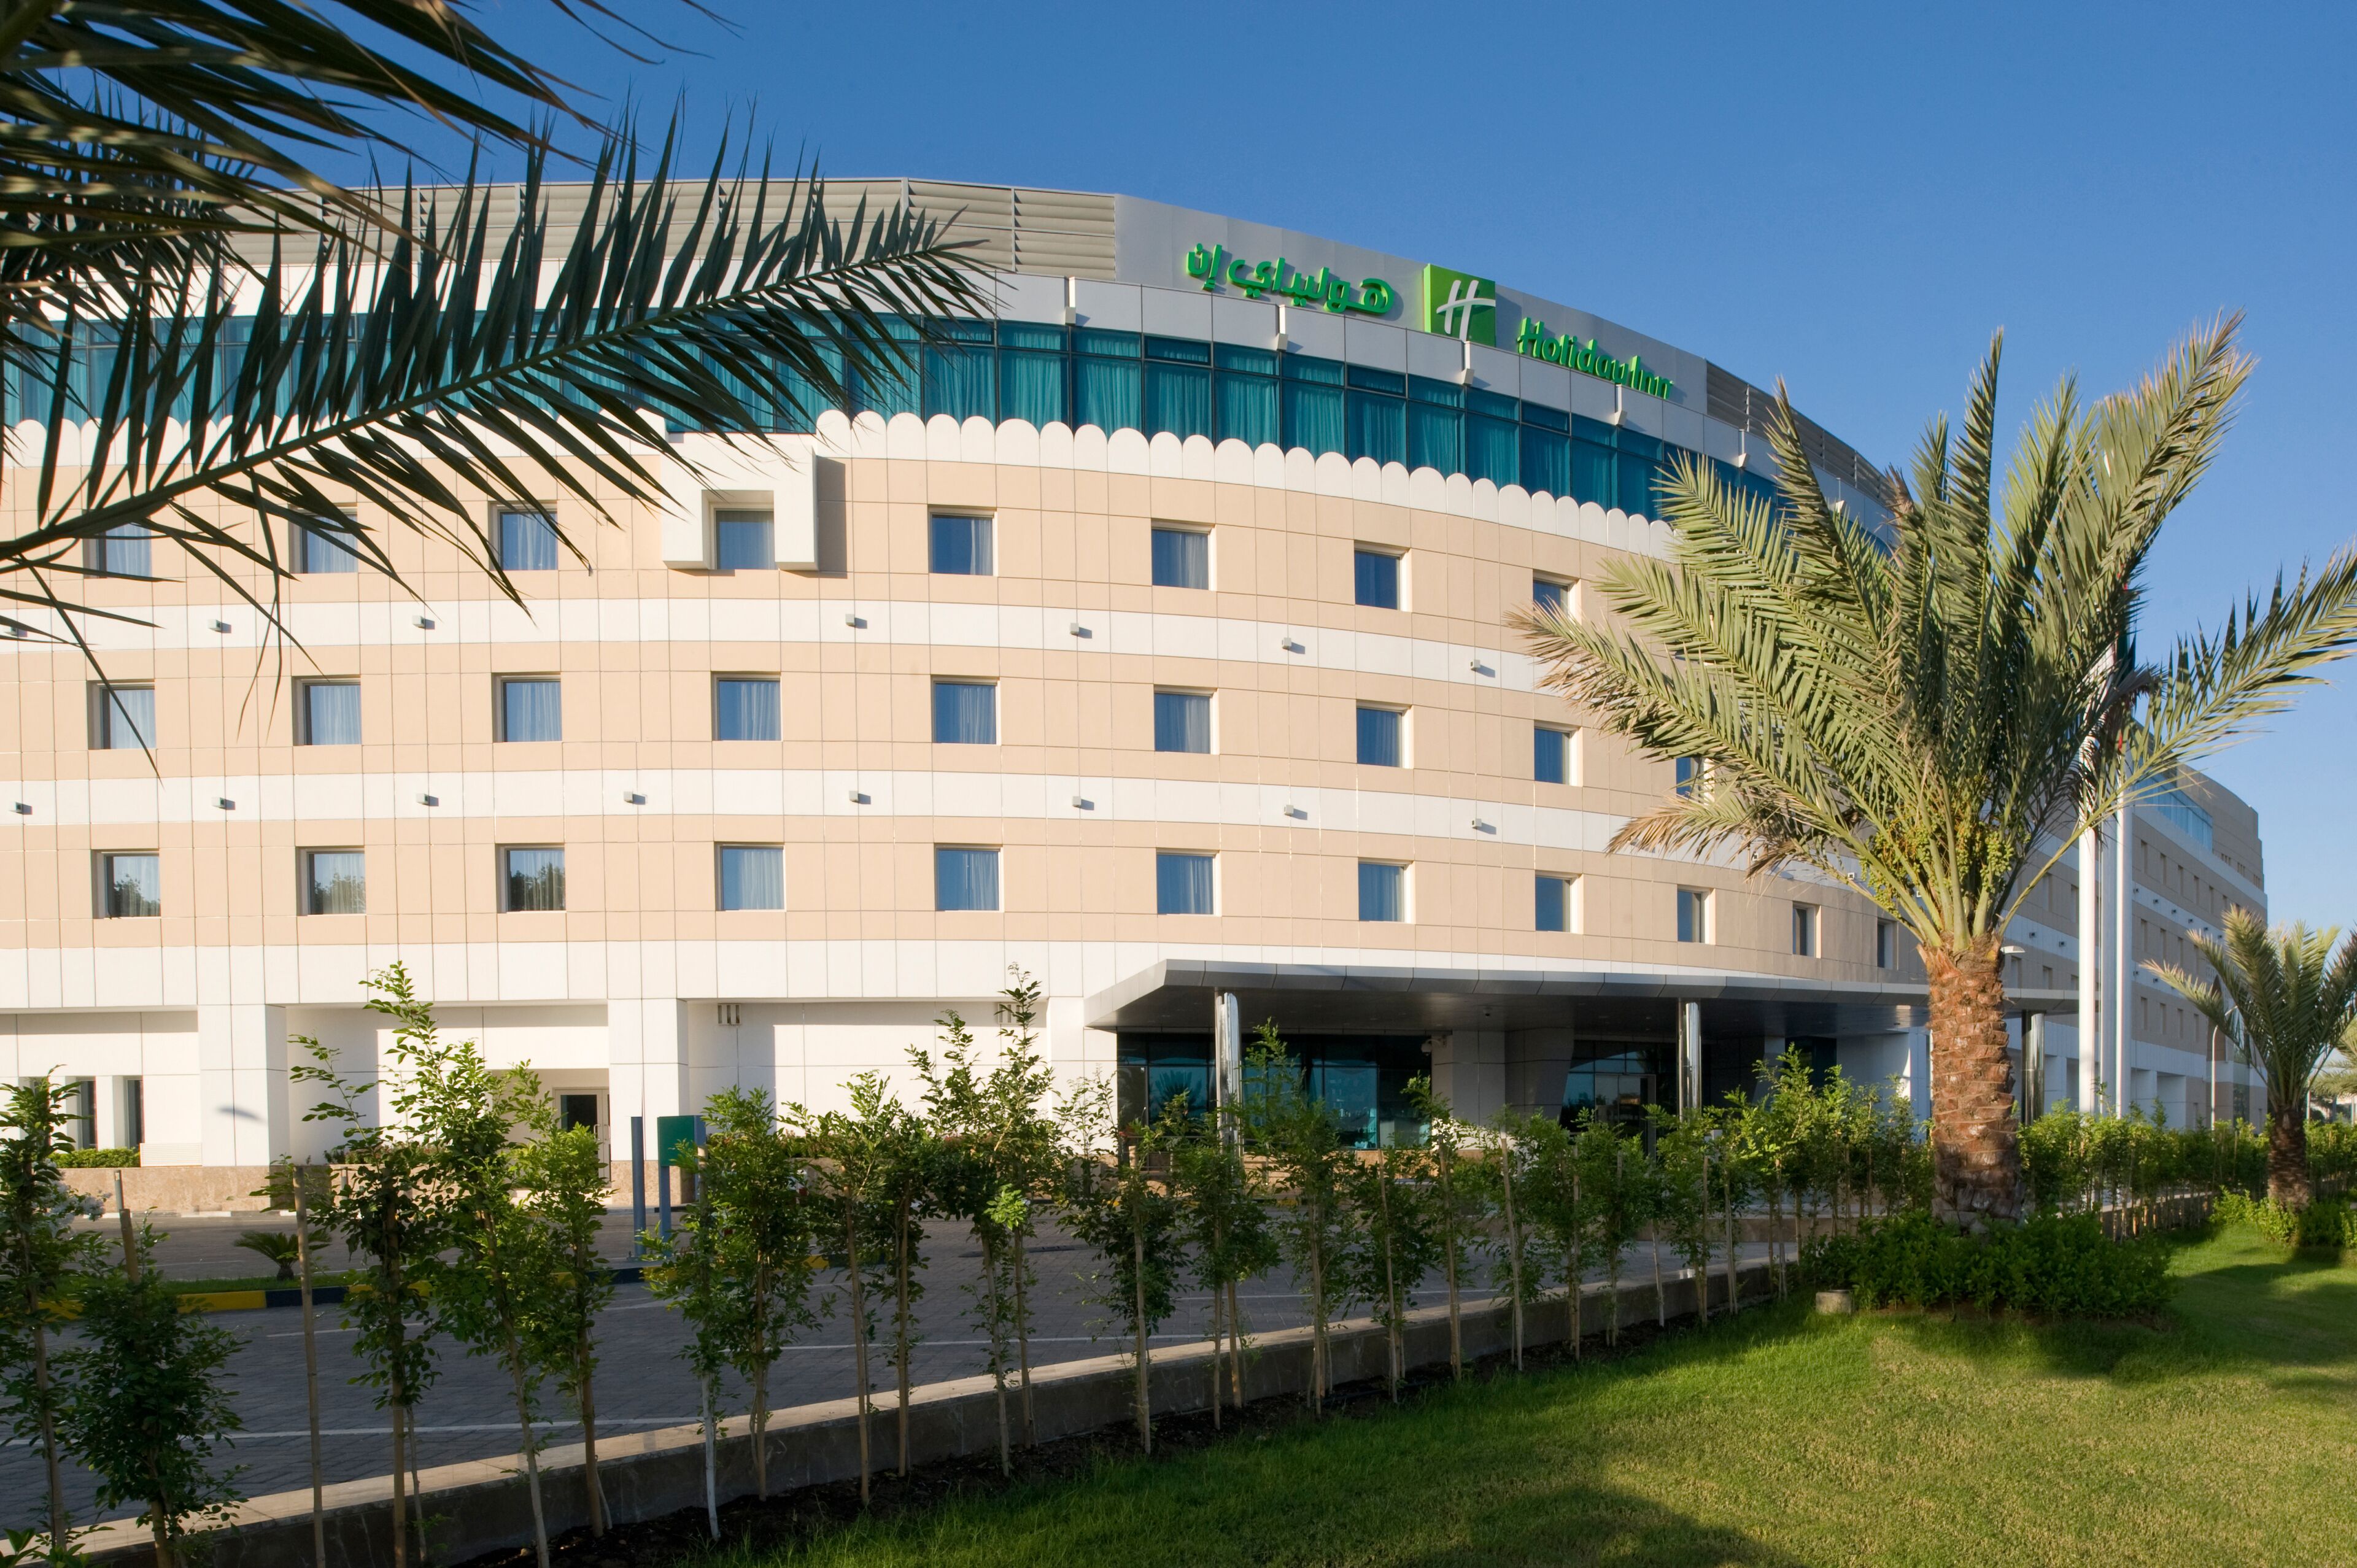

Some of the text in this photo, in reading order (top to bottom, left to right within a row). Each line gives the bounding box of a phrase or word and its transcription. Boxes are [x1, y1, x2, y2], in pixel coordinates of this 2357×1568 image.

[1186, 243, 1395, 314] هوليداي إن
[1517, 317, 1674, 400] Holiday Inn
